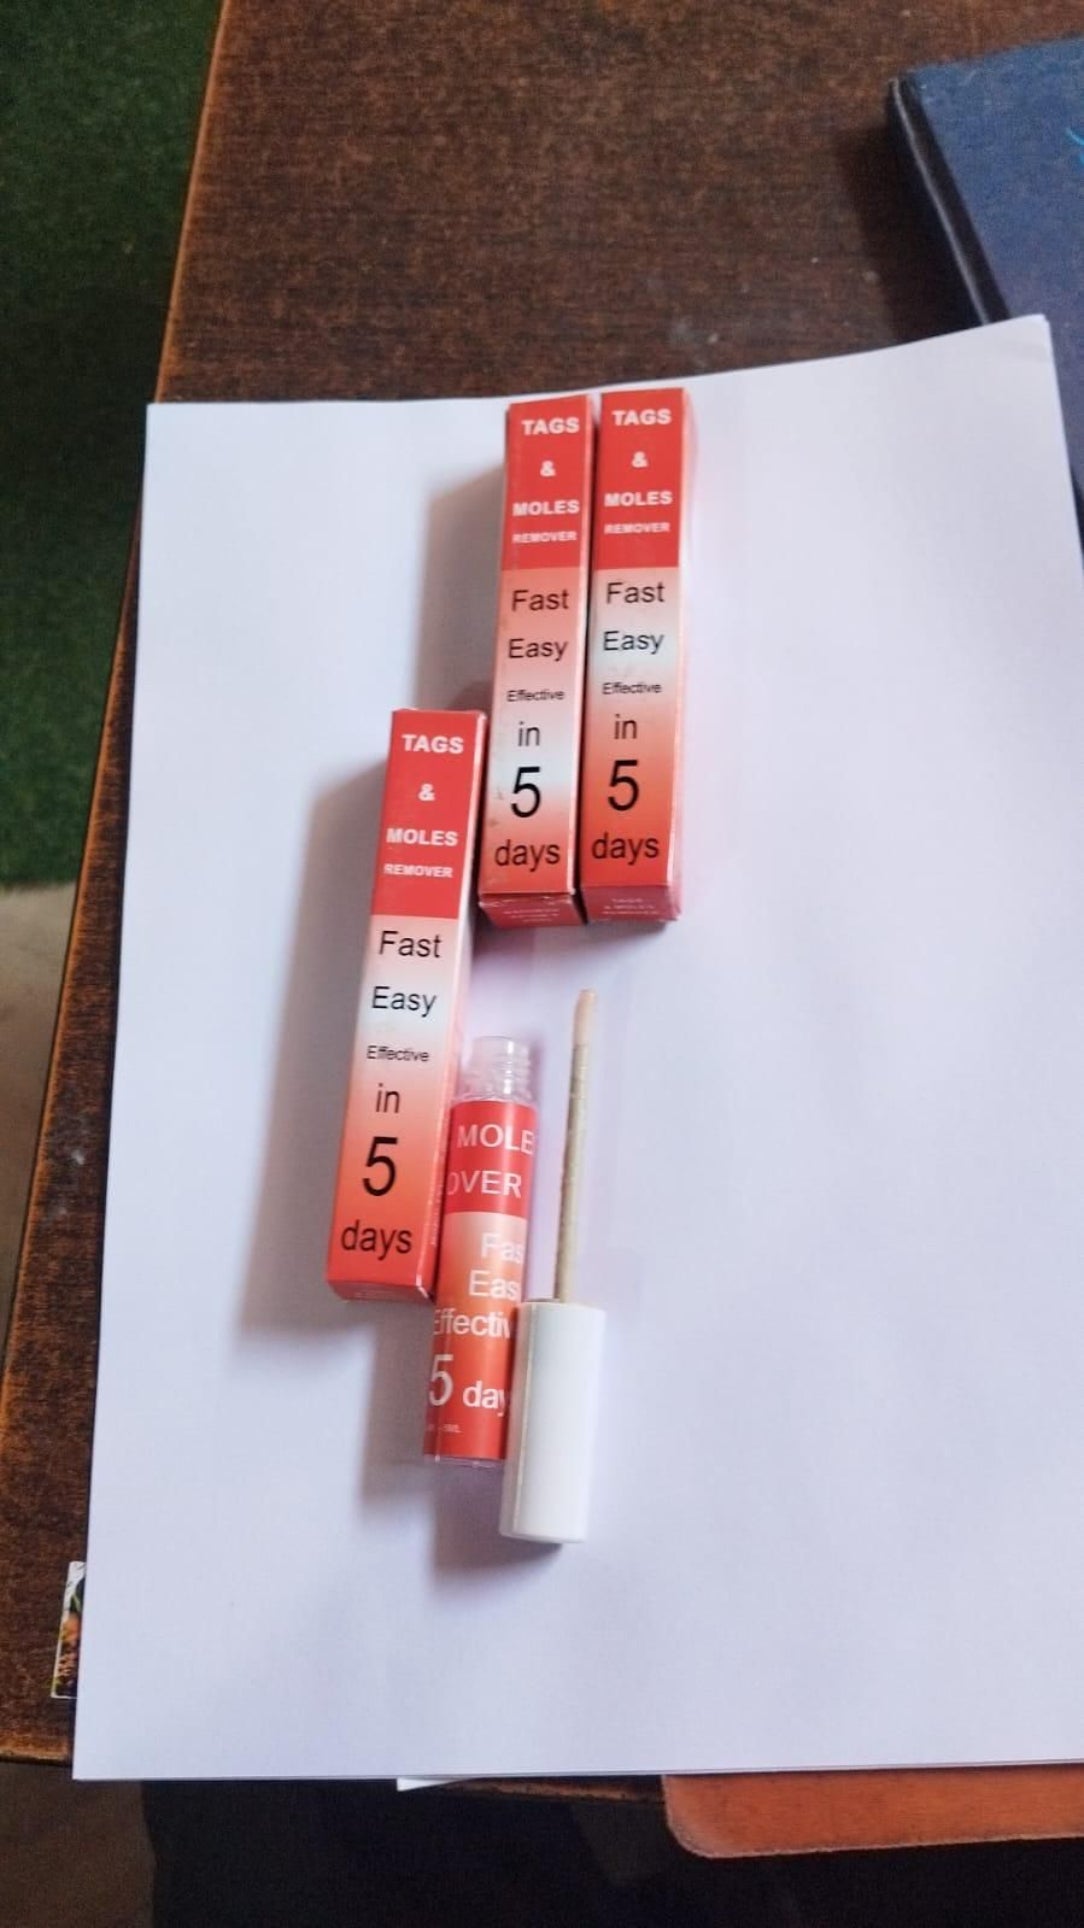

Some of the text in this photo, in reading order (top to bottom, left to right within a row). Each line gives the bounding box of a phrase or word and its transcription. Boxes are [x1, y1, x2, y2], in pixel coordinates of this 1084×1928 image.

[521, 417, 579, 435] TAGS
[612, 409, 671, 426] TAGS
[540, 461, 556, 477] &
[632, 451, 648, 468] &
[512, 500, 579, 516] MOLES
[604, 491, 672, 507] MOLES
[512, 531, 577, 543] REMOVER
[604, 522, 670, 534] REMOVER
[511, 589, 569, 611] Fast
[606, 581, 665, 604] Fast
[508, 638, 568, 662] Easy
[603, 630, 664, 655] Easy
[507, 689, 565, 702] Effective
[602, 682, 662, 695] Effective
[518, 721, 541, 747] in
[614, 713, 638, 740] in
[402, 734, 464, 754] TAGS
[418, 783, 436, 801] &
[510, 766, 541, 818] 5
[607, 759, 640, 811] 5
[386, 828, 458, 846] MOLES
[494, 839, 561, 873] days
[591, 832, 660, 866] days
[383, 863, 453, 878] REMOVER
[379, 930, 442, 958] Fast
[372, 986, 437, 1018] Easy
[366, 1045, 430, 1062] Effective
[376, 1083, 400, 1114] in
[457, 1123, 536, 1155] MOLE
[362, 1136, 398, 1197] 5
[340, 1218, 413, 1262] days
[428, 1353, 454, 1407] 5
